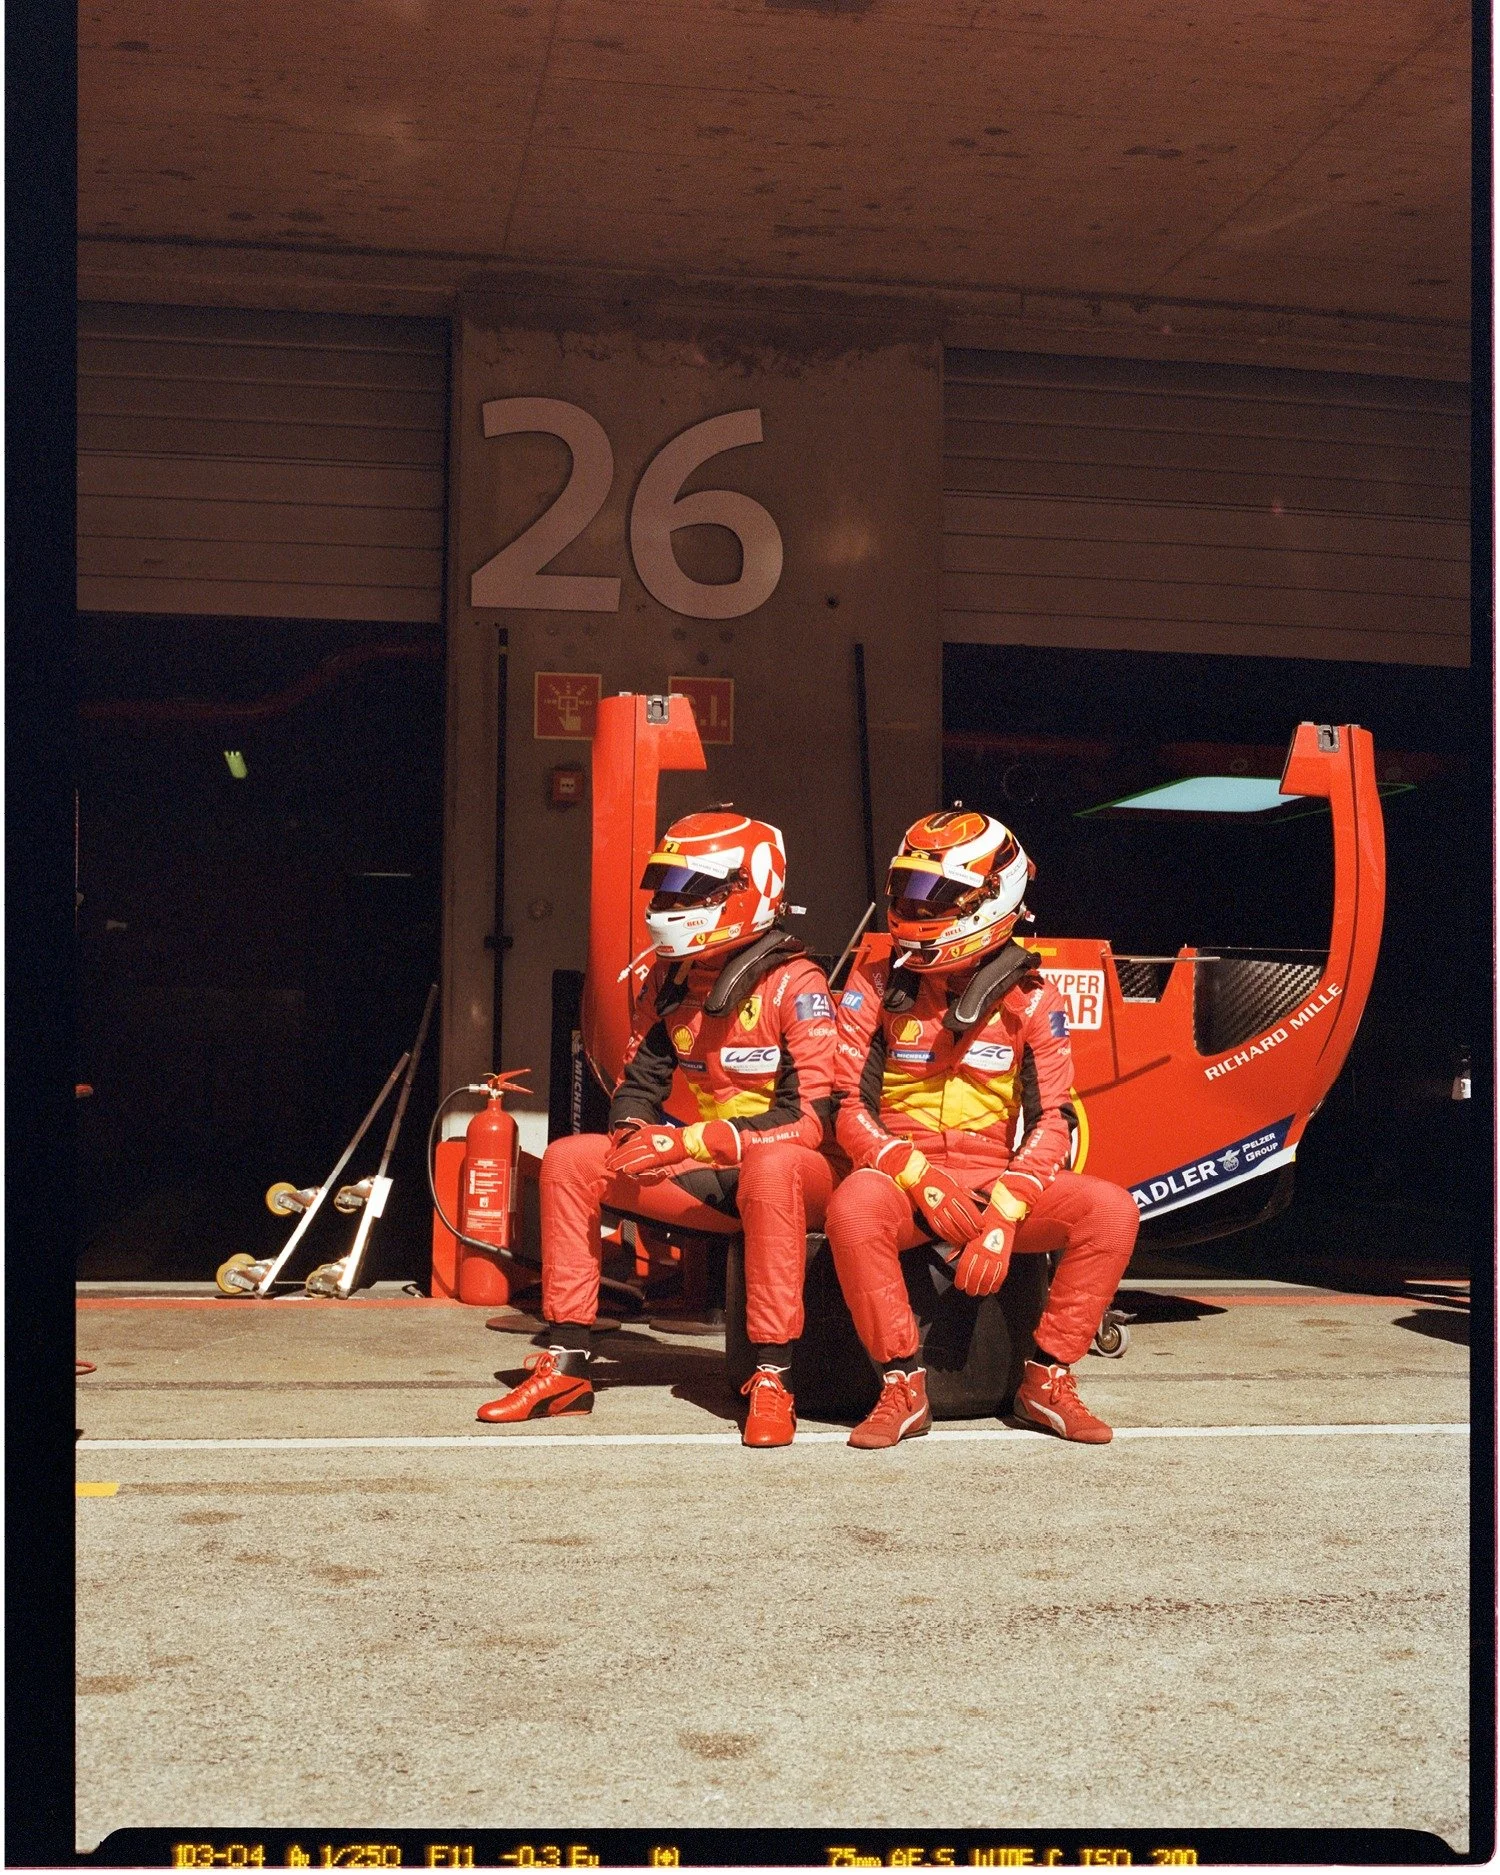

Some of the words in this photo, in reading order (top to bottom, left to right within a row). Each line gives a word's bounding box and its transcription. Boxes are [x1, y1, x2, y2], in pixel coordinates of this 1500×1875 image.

[471, 397, 783, 619] 26
[686, 919, 704, 927] BELL
[945, 926, 962, 937] BELL
[1045, 974, 1100, 993] YPER
[1062, 995, 1098, 1024] AR
[1204, 1028, 1289, 1081] RICHARD
[1289, 983, 1343, 1030] MILLE
[725, 1048, 777, 1062] WEC
[1242, 1132, 1276, 1152] PELZER
[1245, 1142, 1279, 1162] GROUP
[1132, 1160, 1218, 1208] ADLER
